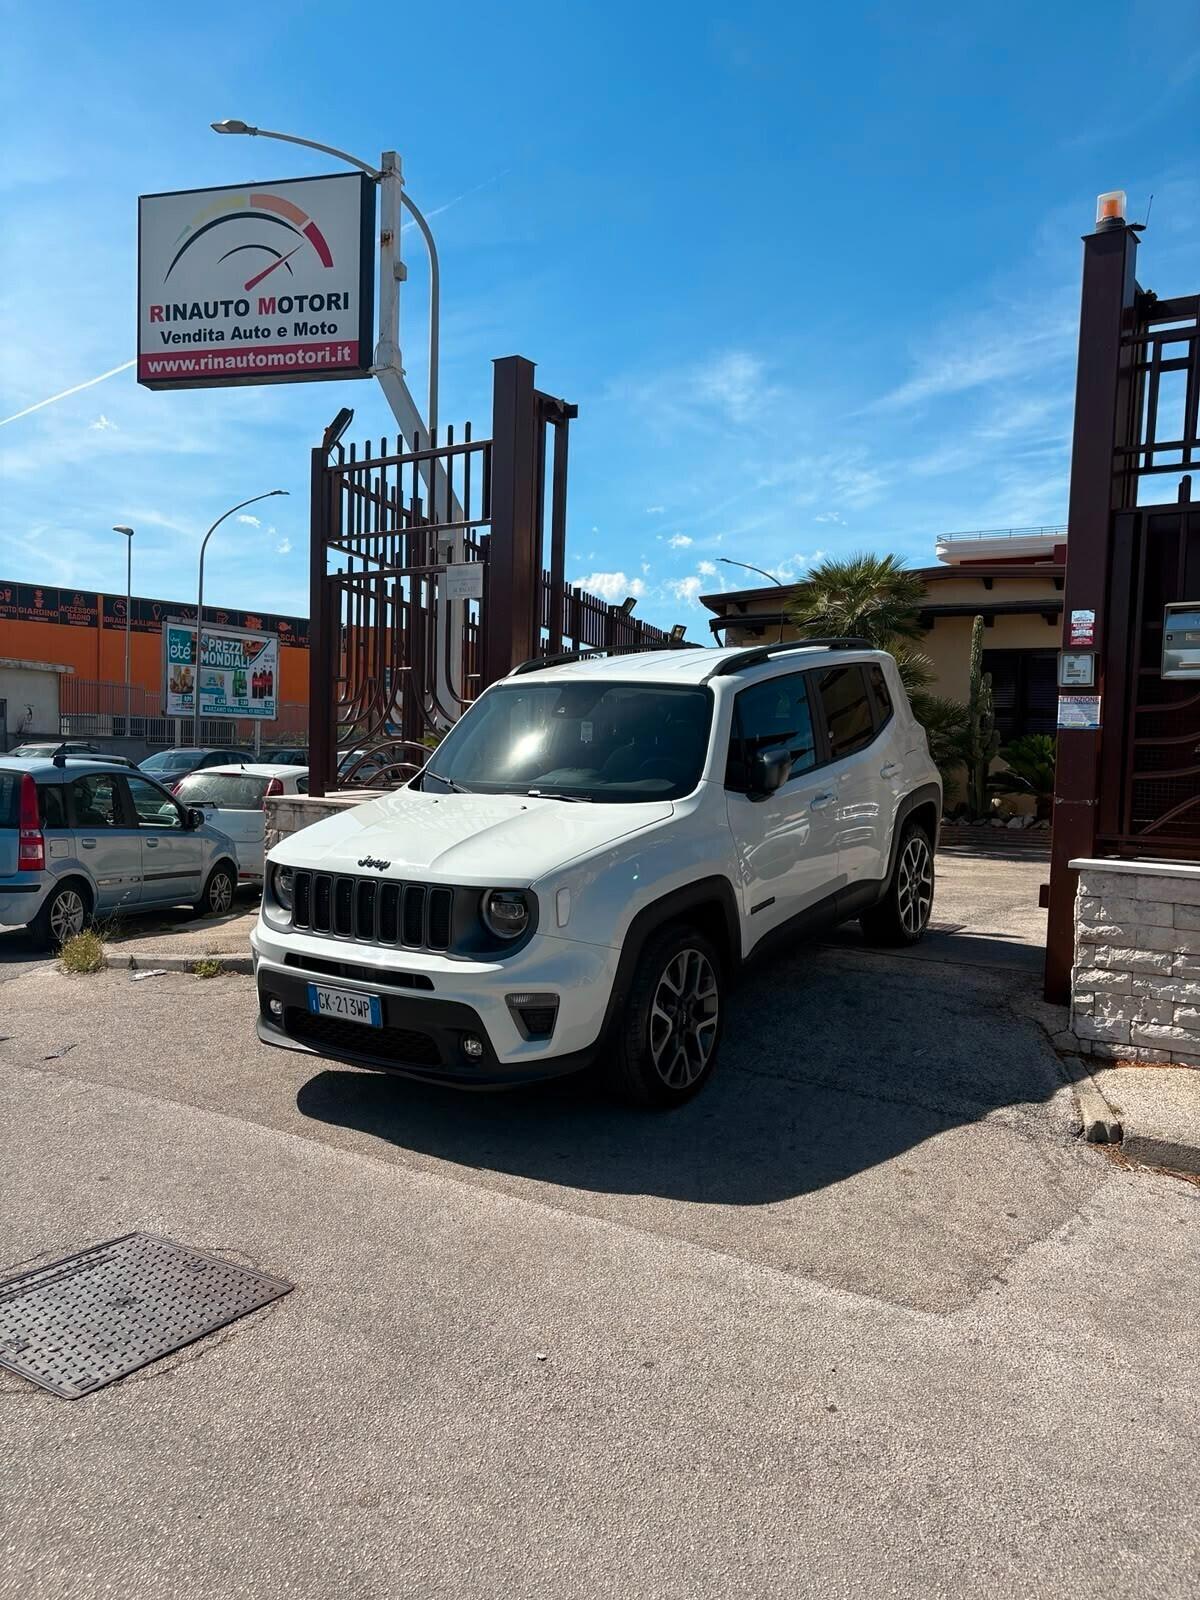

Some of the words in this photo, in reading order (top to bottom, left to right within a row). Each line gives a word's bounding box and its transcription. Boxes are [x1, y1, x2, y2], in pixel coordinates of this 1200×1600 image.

[150, 299, 250, 323] RINAUTO
[258, 292, 349, 315] MOTORI
[160, 328, 225, 345] Vendita
[230, 325, 272, 341] Auto
[277, 324, 288, 338] e
[294, 321, 338, 337] Moto
[147, 346, 351, 373] www.rinautomotori.it
[18, 608, 58, 617] GIARDINO
[60, 605, 98, 616] ACCESSORI
[103, 617, 138, 625] IDRAULCA
[170, 642, 191, 660] eté
[208, 639, 243, 655] PREZZI
[200, 650, 250, 668] MONDIALI
[358, 855, 391, 871] Jeep
